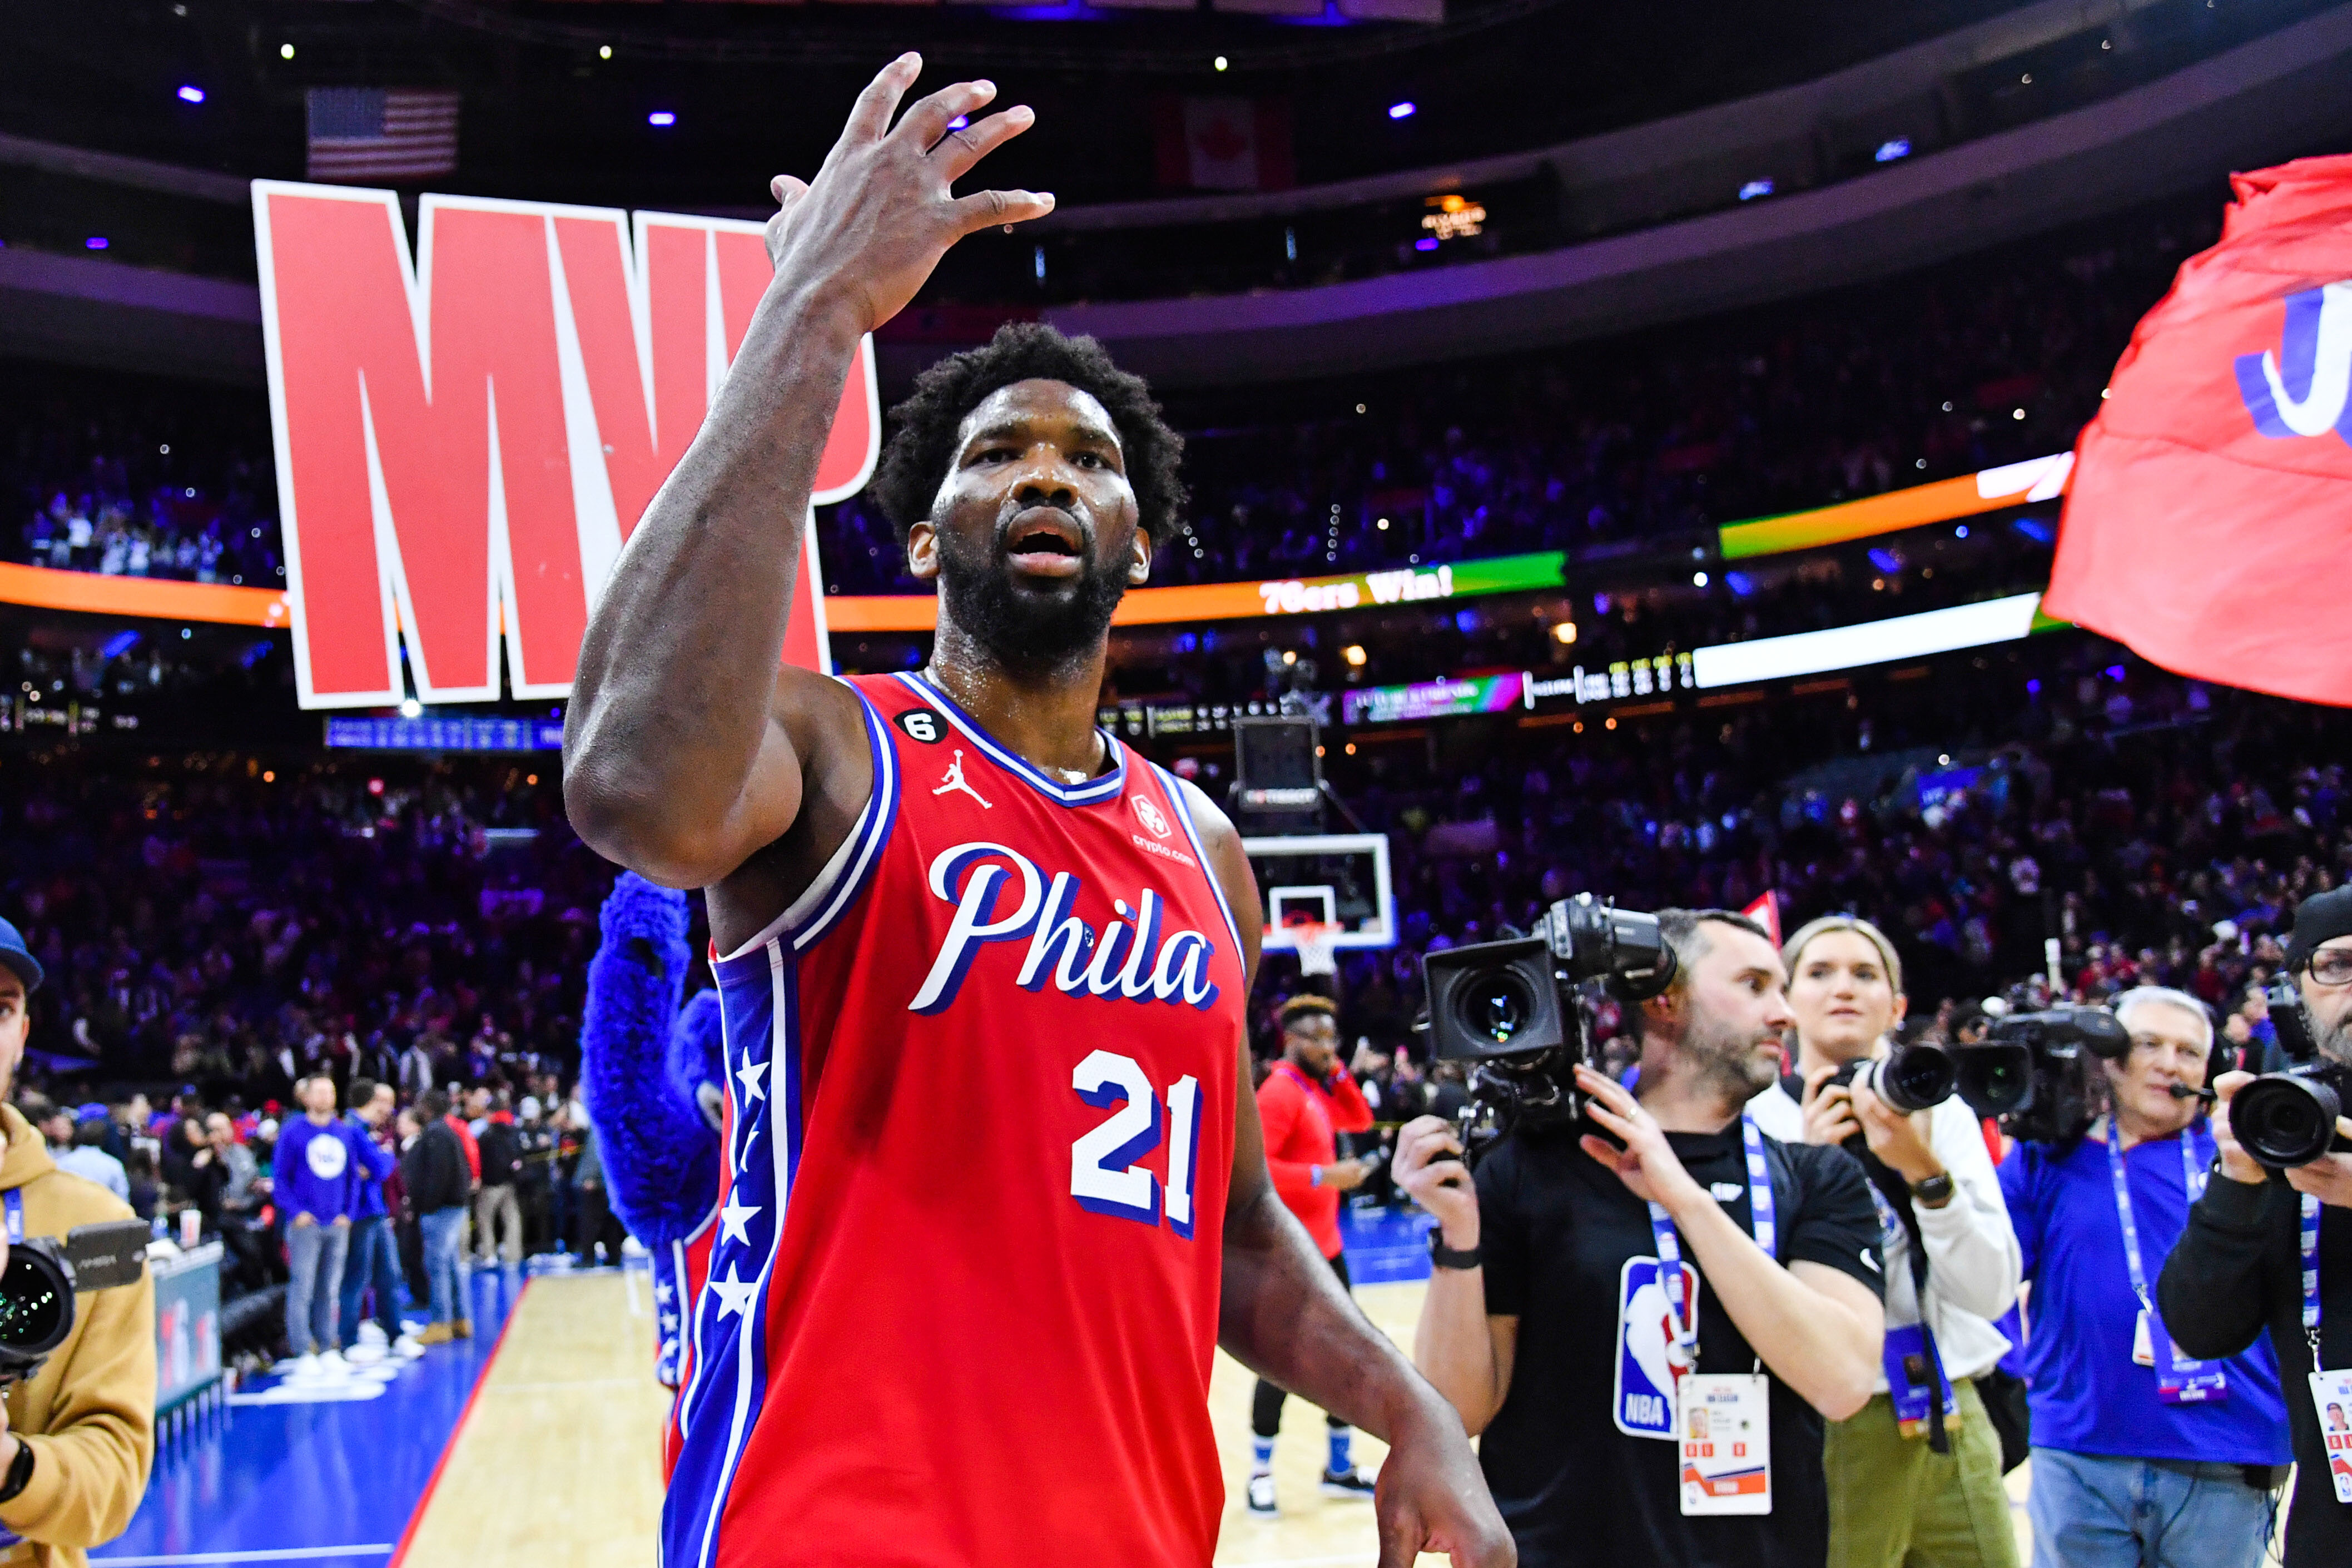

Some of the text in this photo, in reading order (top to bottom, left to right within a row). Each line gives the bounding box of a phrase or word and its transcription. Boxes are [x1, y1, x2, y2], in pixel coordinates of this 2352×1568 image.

[1259, 565, 1454, 614] 76ers Win!
[904, 713, 936, 741] 6
[1133, 834, 1195, 867] crypto.com
[908, 842, 1219, 1016] Phila
[1070, 1049, 1204, 1241] 21
[1625, 1392, 1665, 1427] NBA
